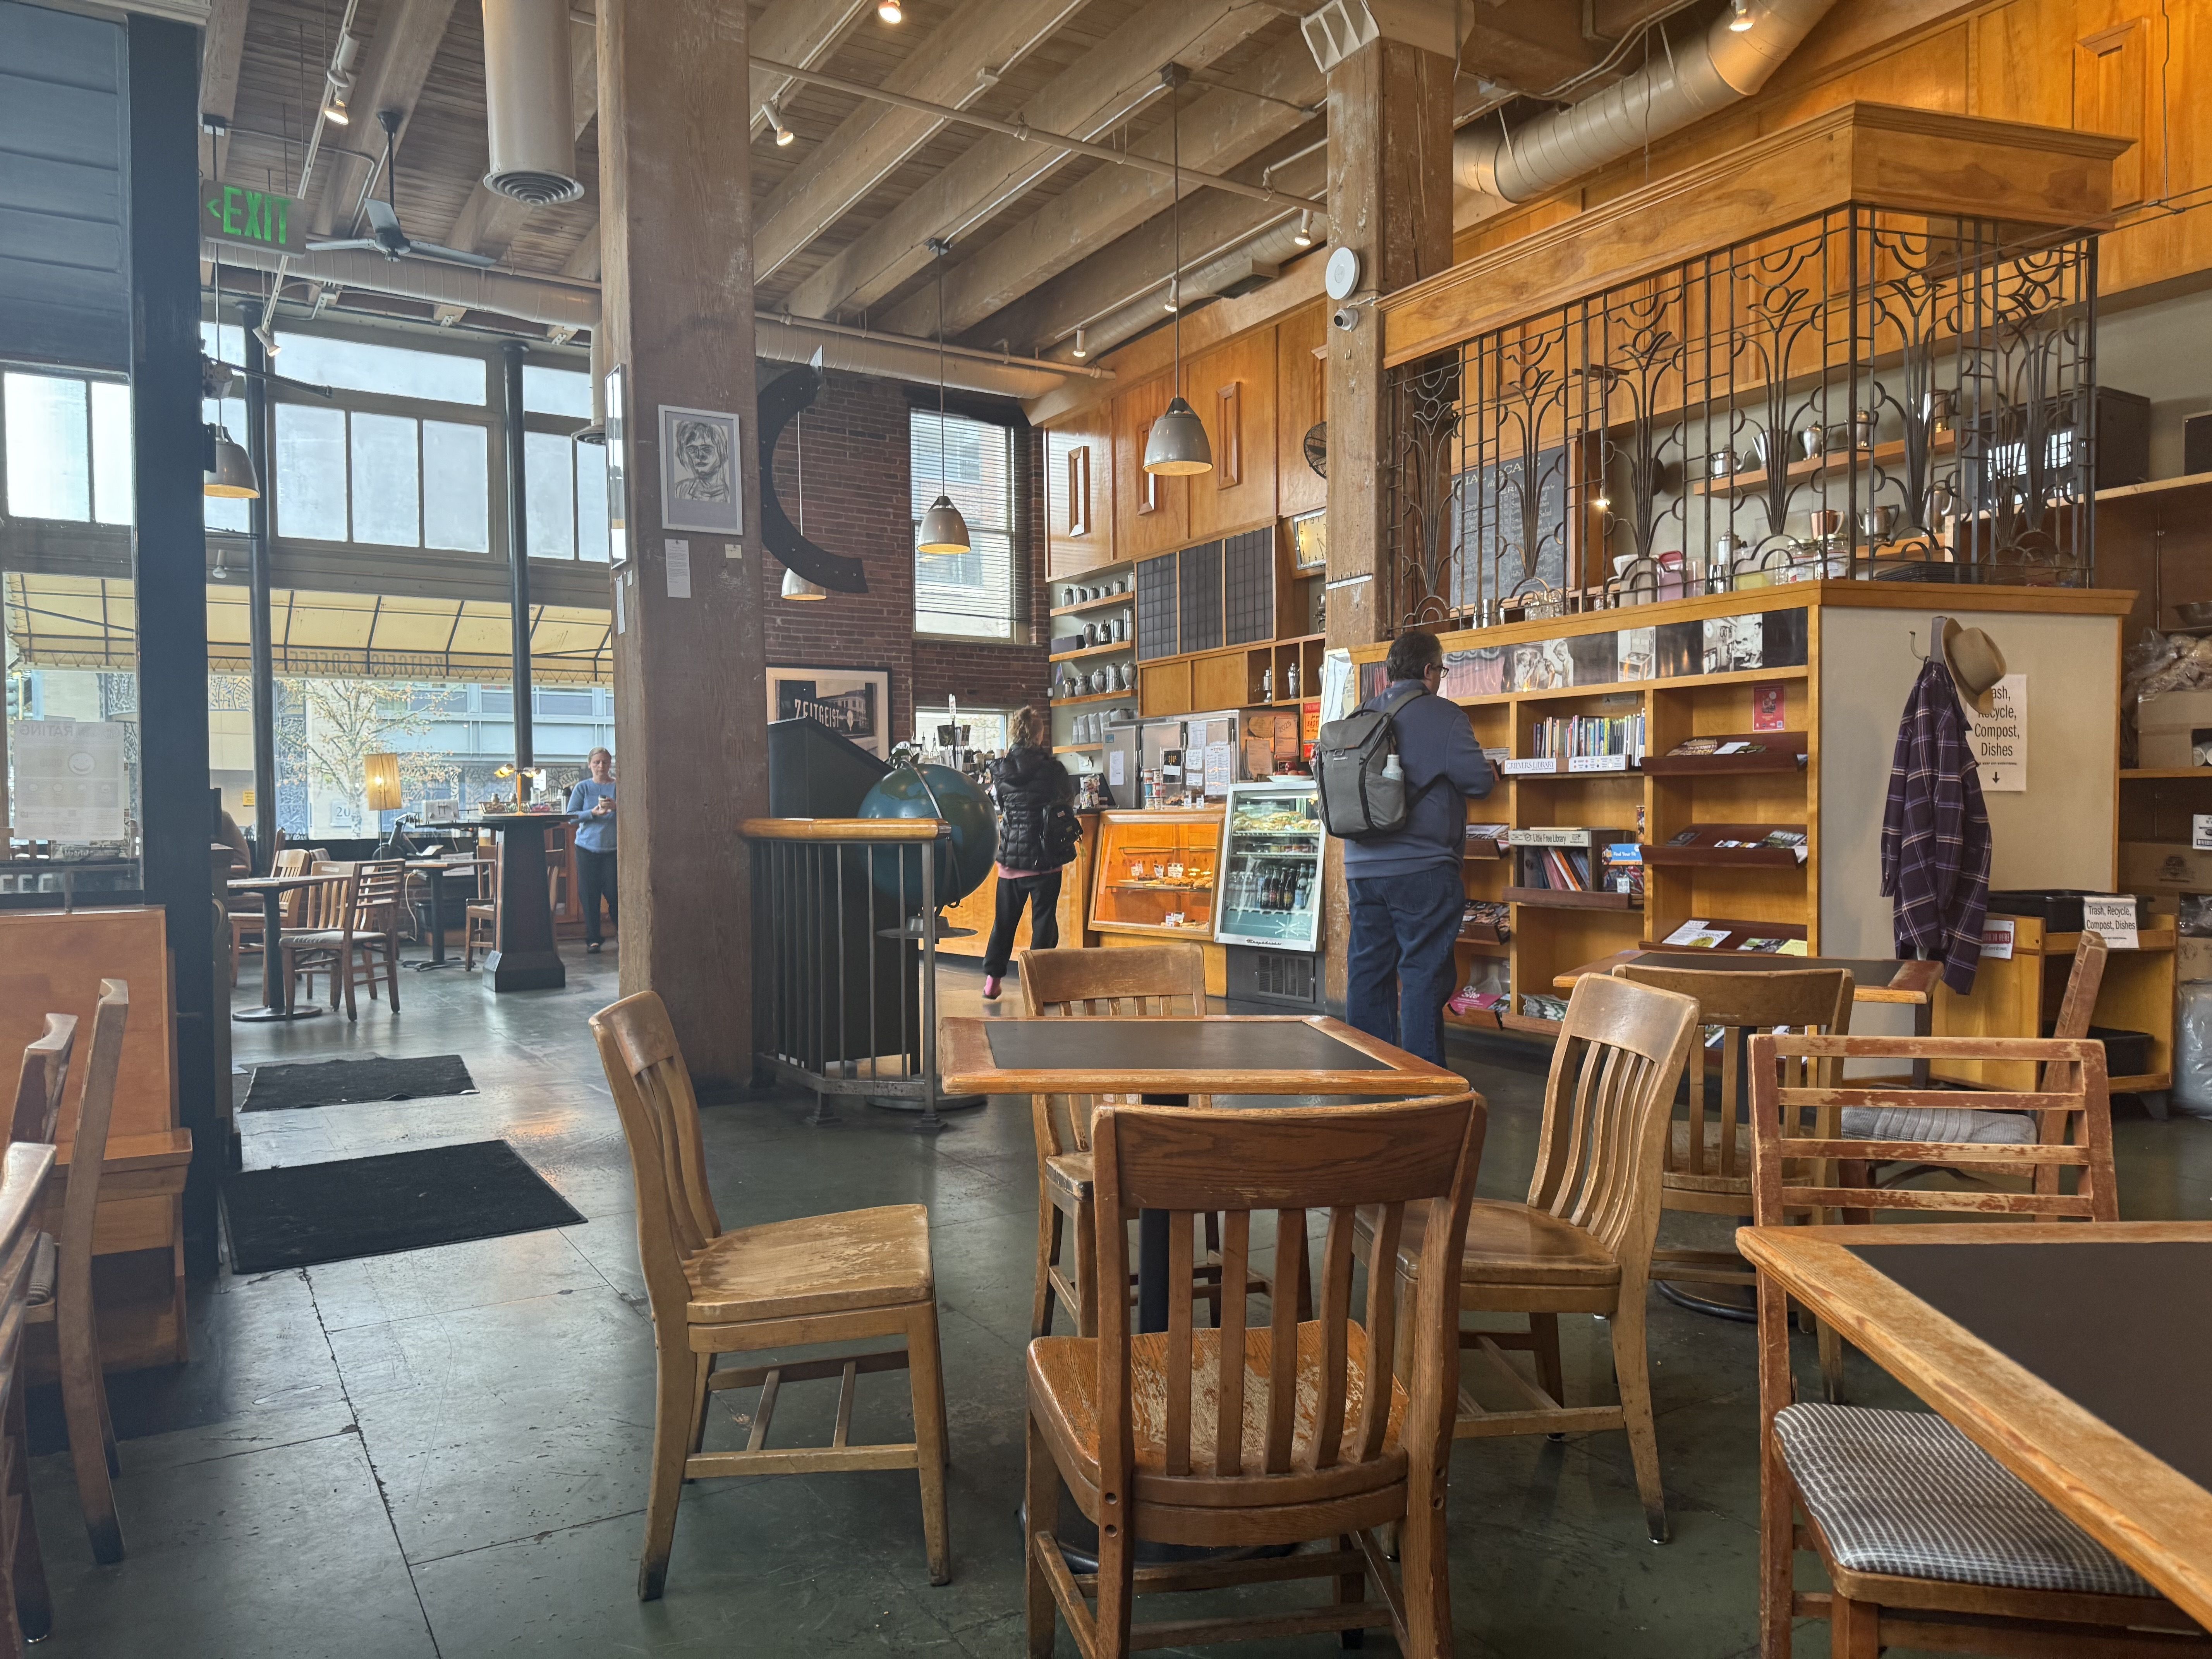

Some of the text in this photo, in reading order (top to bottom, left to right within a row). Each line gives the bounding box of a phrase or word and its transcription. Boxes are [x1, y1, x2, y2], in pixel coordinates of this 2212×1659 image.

[223, 185, 293, 245] EXIT
[1993, 685, 2011, 701] ash,
[795, 699, 840, 728] ZEITGEIST
[1279, 721, 1292, 733] 2025
[1975, 723, 2020, 740] Compost,
[1981, 742, 2013, 756] Dishes
[1553, 834, 1566, 844] Library
[2089, 906, 2131, 917] Trash, Recycle,
[2087, 920, 2136, 931] Compost, Dishes
